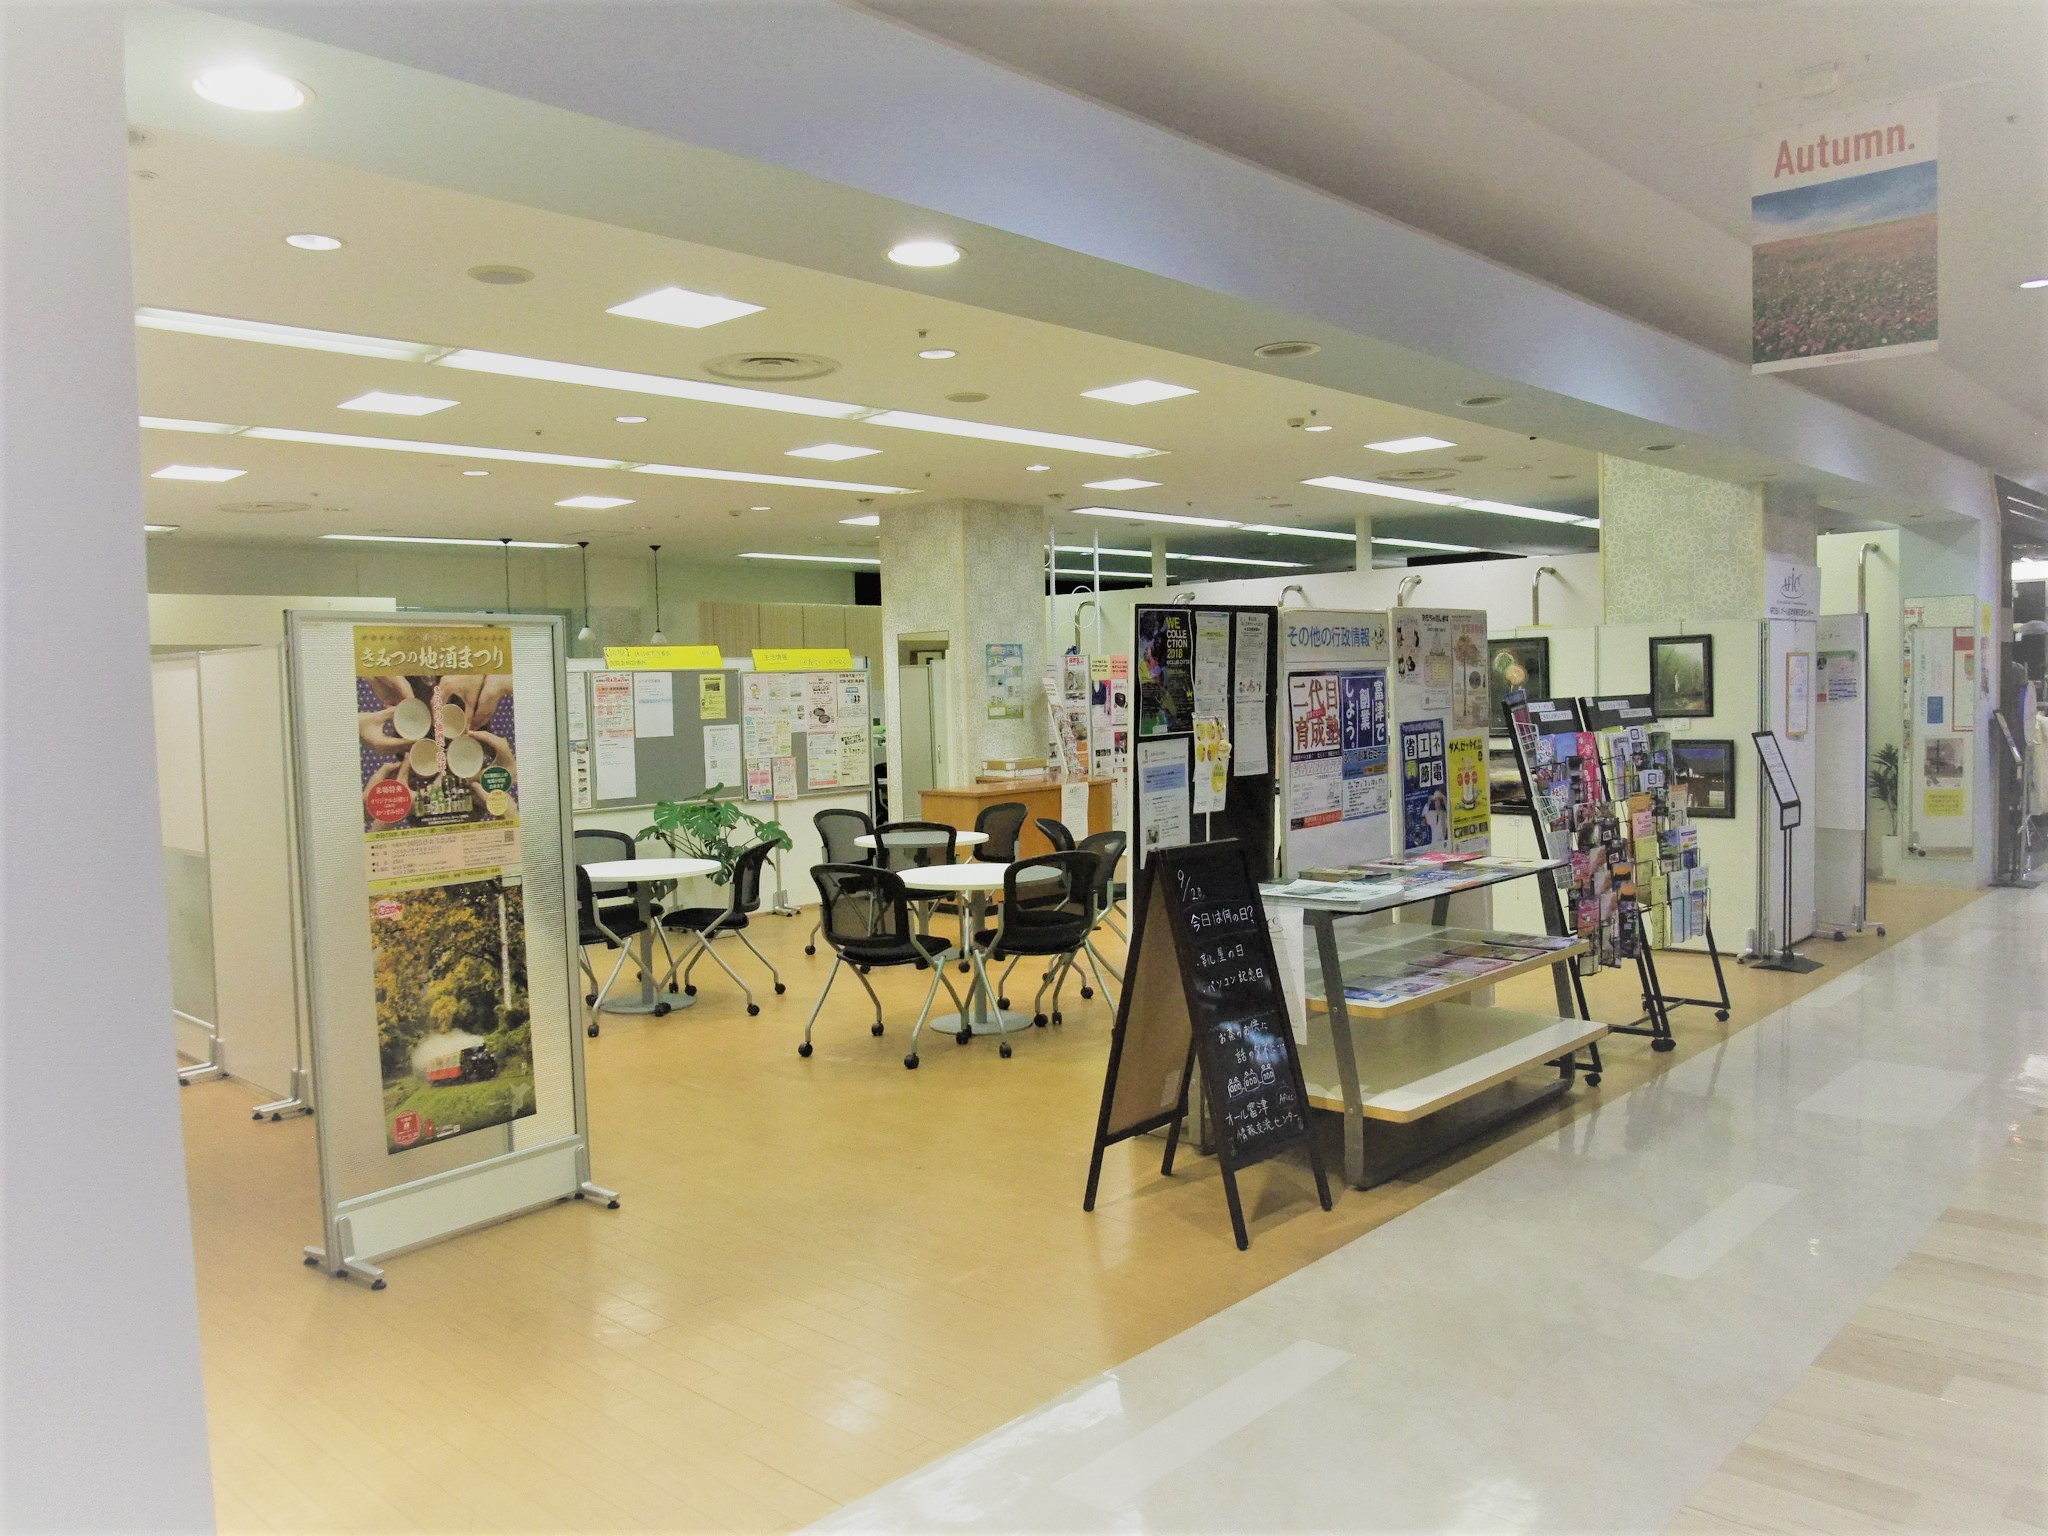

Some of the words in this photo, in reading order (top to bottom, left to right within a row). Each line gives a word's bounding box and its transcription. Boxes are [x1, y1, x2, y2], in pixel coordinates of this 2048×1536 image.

[1773, 123, 1916, 178] Autumn.
[1166, 616, 1181, 629] WE
[1166, 629, 1188, 639] COLLE
[1166, 639, 1188, 649] CTION
[1287, 625, 1370, 648] その他の行政情報
[361, 645, 504, 671] きみつの地酒まつり
[1166, 648, 1183, 659] 2018
[1293, 679, 1338, 712] 二代目
[1359, 687, 1371, 731] 創業
[1373, 679, 1385, 742] 富津で
[1294, 714, 1340, 751] 育成塾
[1405, 734, 1442, 757] 省エネ
[1420, 763, 1442, 784] 節電
[1190, 905, 1255, 933] 今日は何の日?
[1225, 1097, 1269, 1127] オール富津
